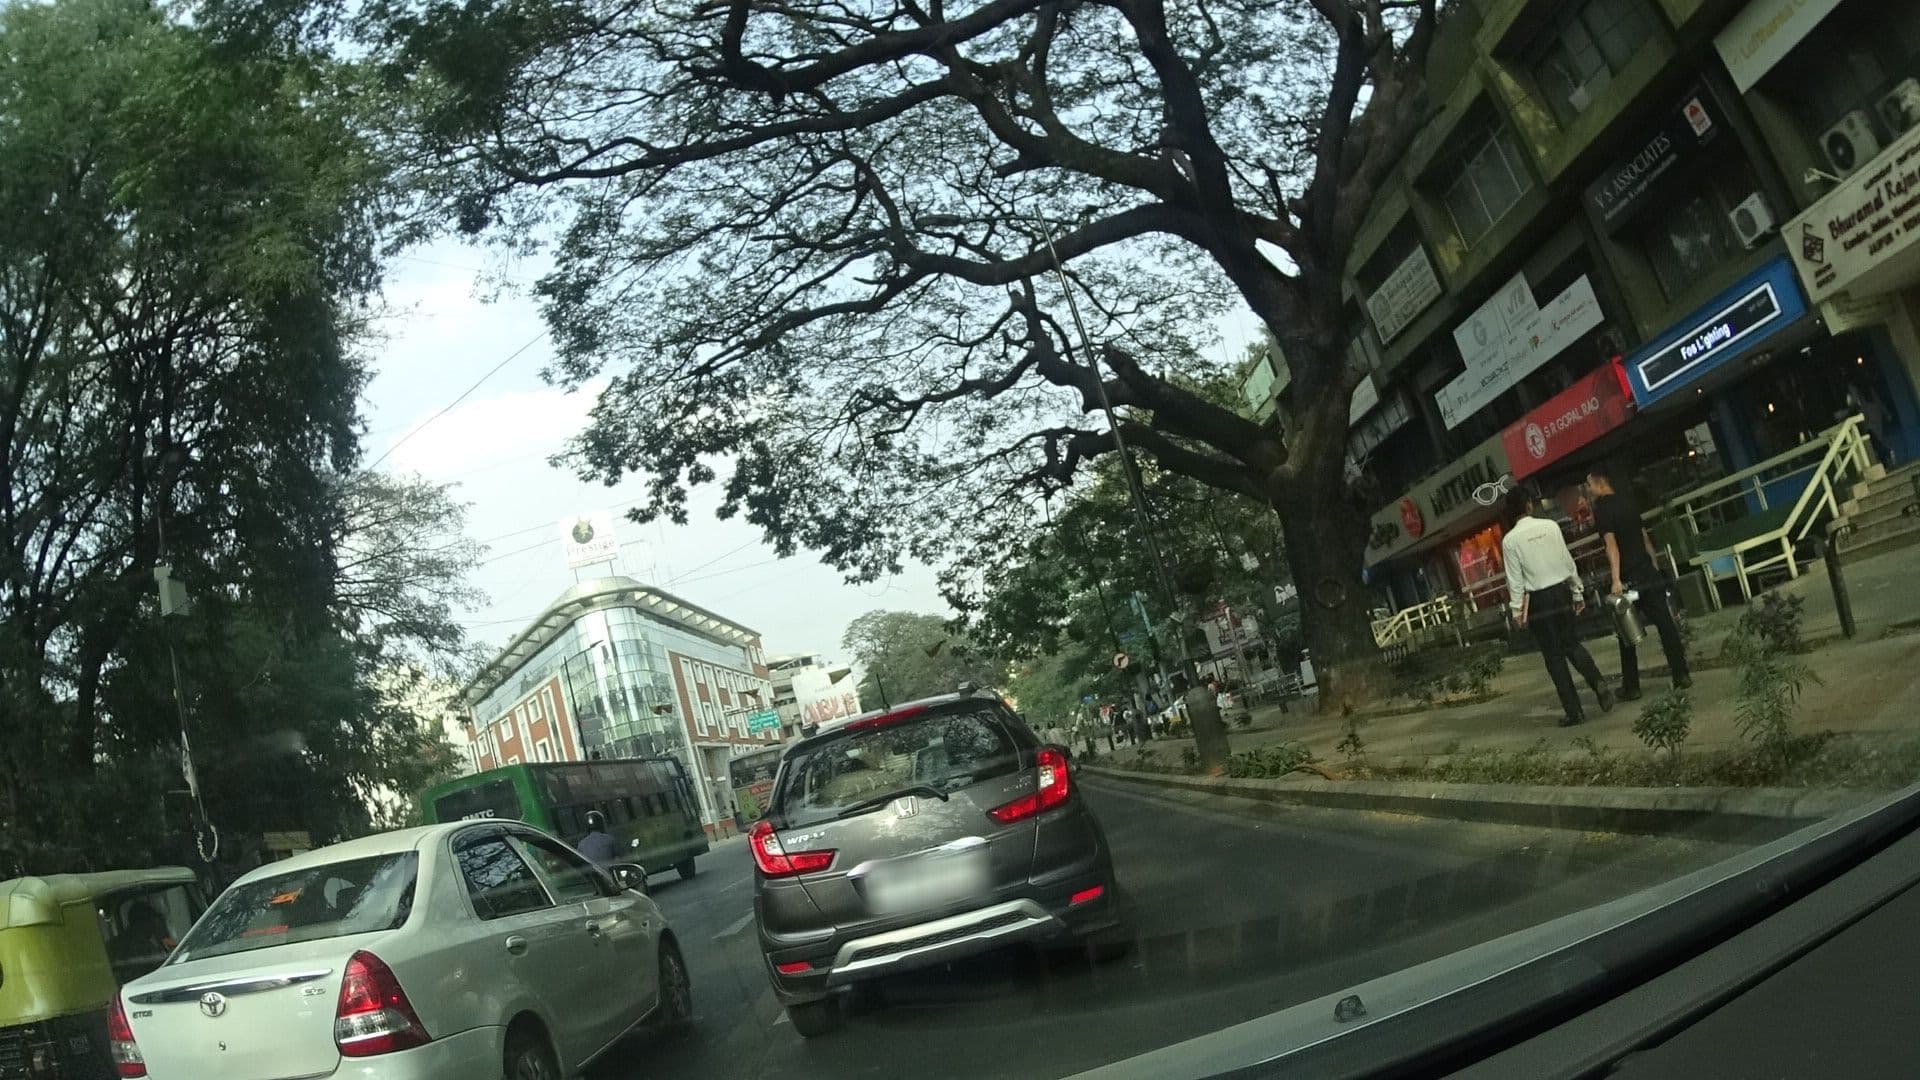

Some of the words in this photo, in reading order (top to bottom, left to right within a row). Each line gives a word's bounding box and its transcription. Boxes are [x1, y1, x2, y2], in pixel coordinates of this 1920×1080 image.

[1612, 131, 1672, 192] ASSOCIATES
[1679, 341, 1697, 361] Fos
[1556, 407, 1584, 430] GOPAL
[1581, 396, 1600, 417] RAO
